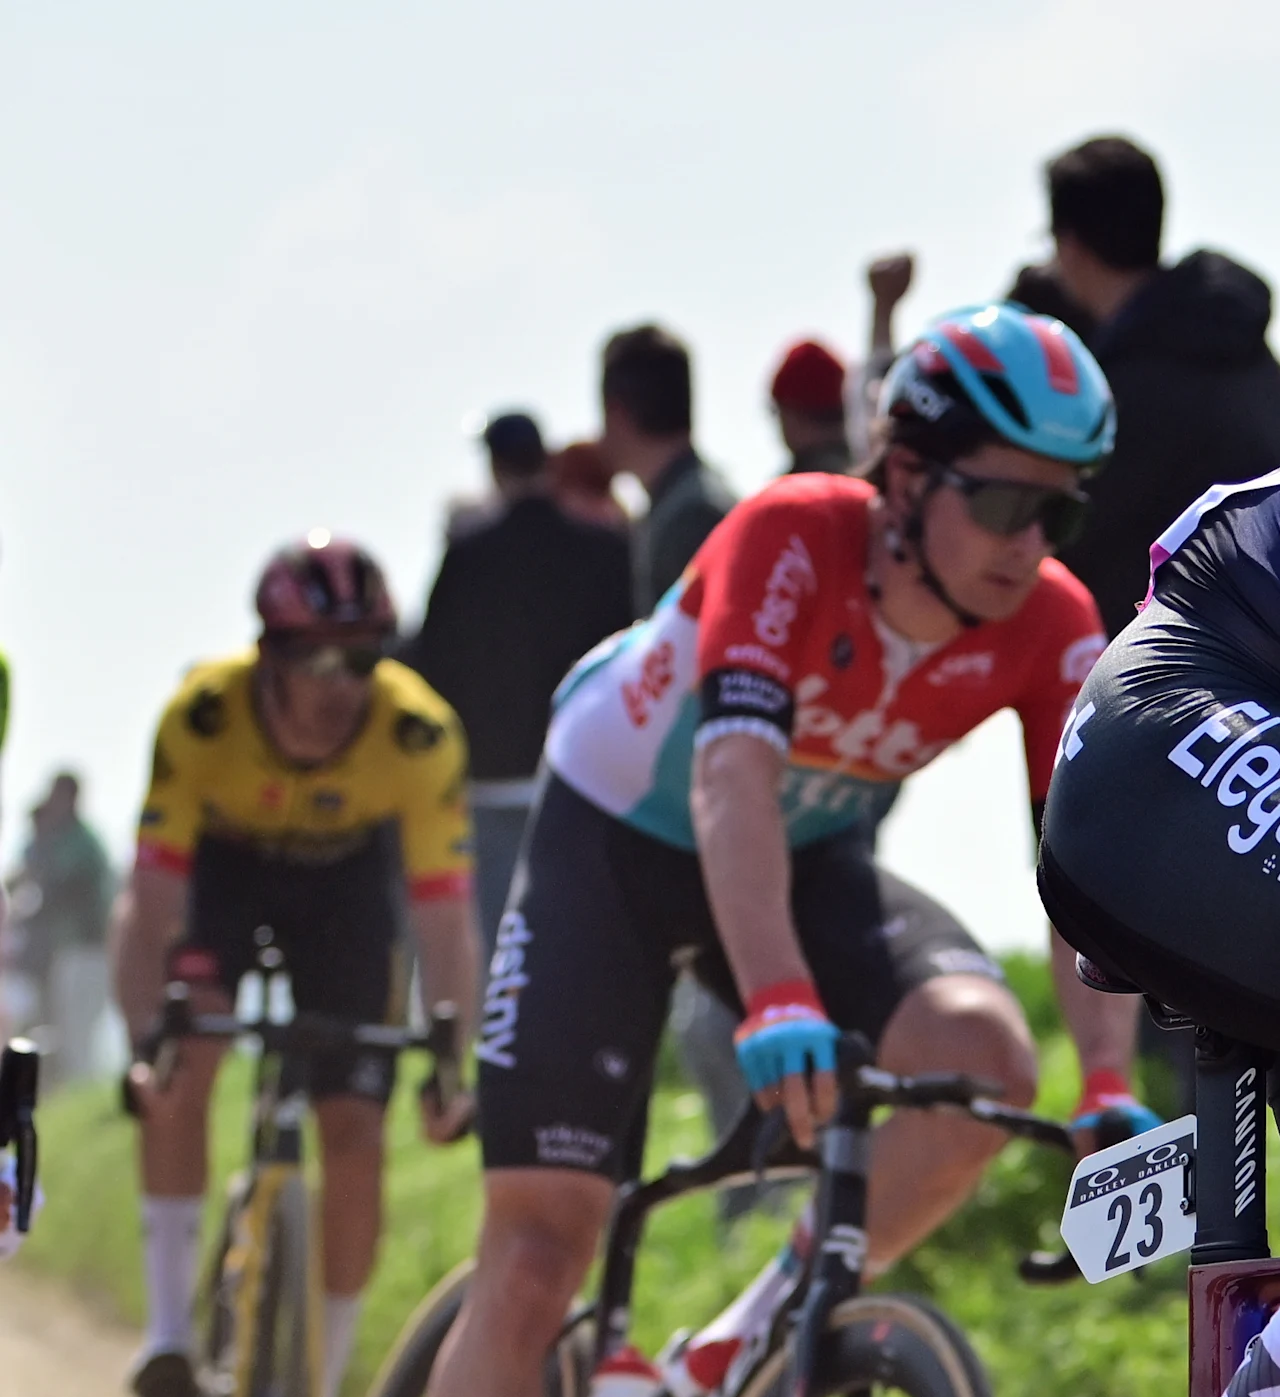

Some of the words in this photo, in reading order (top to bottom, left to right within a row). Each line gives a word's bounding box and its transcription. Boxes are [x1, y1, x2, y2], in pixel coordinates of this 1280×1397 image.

[1234, 1067, 1258, 1219] CANYON
[1080, 1177, 1127, 1203] OAKLEY
[1105, 1182, 1164, 1263] 23
